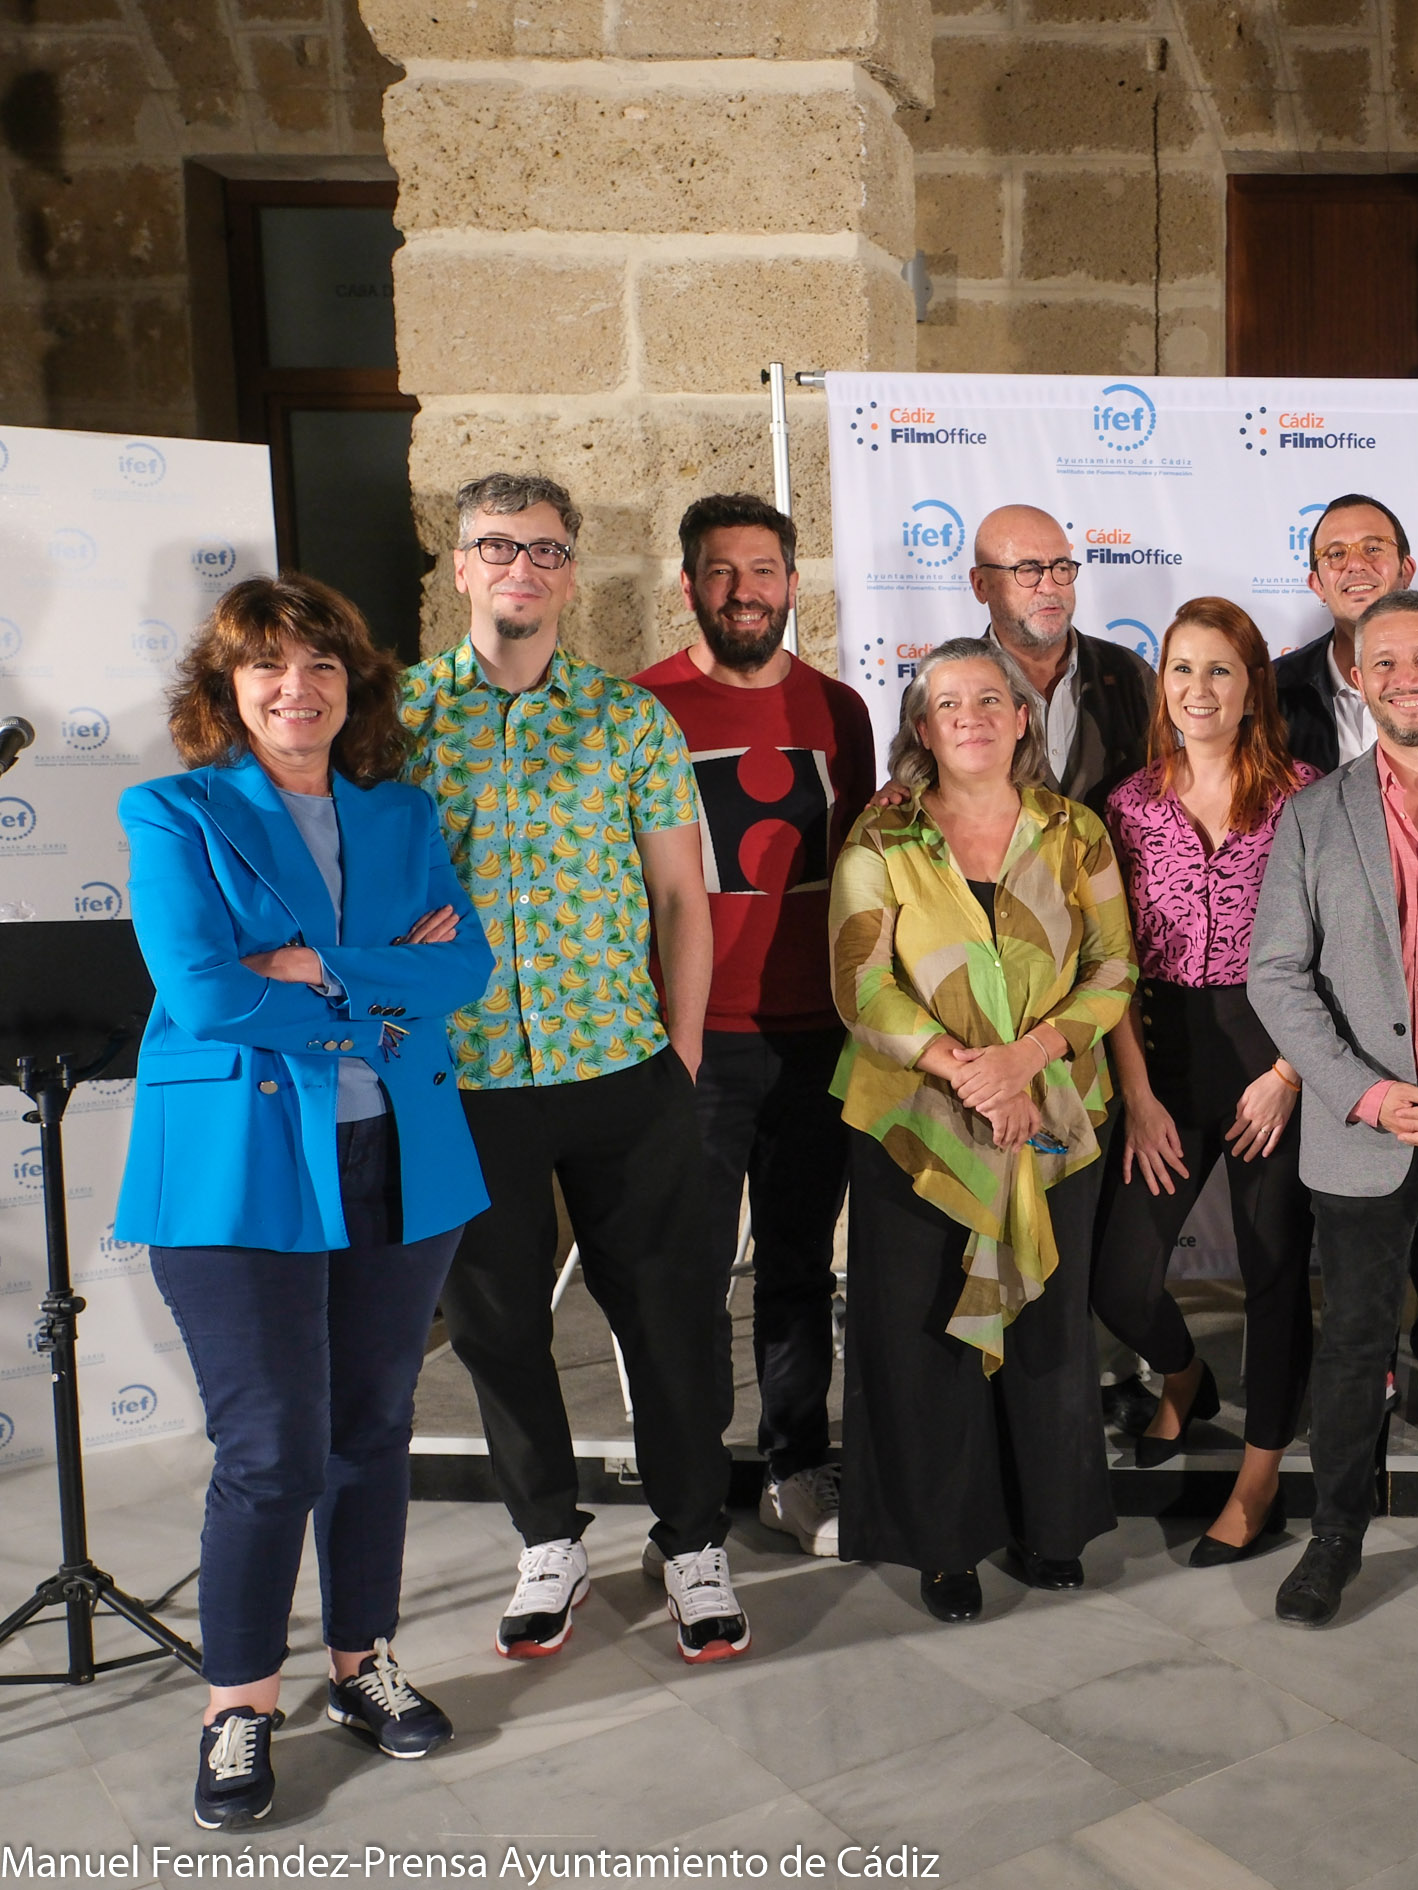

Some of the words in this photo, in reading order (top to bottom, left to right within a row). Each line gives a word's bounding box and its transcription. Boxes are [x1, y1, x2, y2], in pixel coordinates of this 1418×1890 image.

[889, 407, 935, 423] Cádiz
[1093, 405, 1144, 431] ifef
[1278, 412, 1325, 428] Cádiz
[891, 428, 987, 444] FilmOffice
[1279, 432, 1376, 449] FilmOffice
[1056, 456, 1134, 465] Ayuntamiento
[1141, 457, 1154, 465] de
[1160, 457, 1192, 466] Cádiz
[902, 521, 953, 547] ifef
[1085, 528, 1131, 544] Cádiz
[1086, 548, 1183, 565] FilmOffice
[867, 573, 944, 581] Ayuntamiento
[951, 572, 963, 580] de
[62, 721, 102, 738] ifef
[74, 895, 115, 913] ifef
[111, 1395, 149, 1416] ifef
